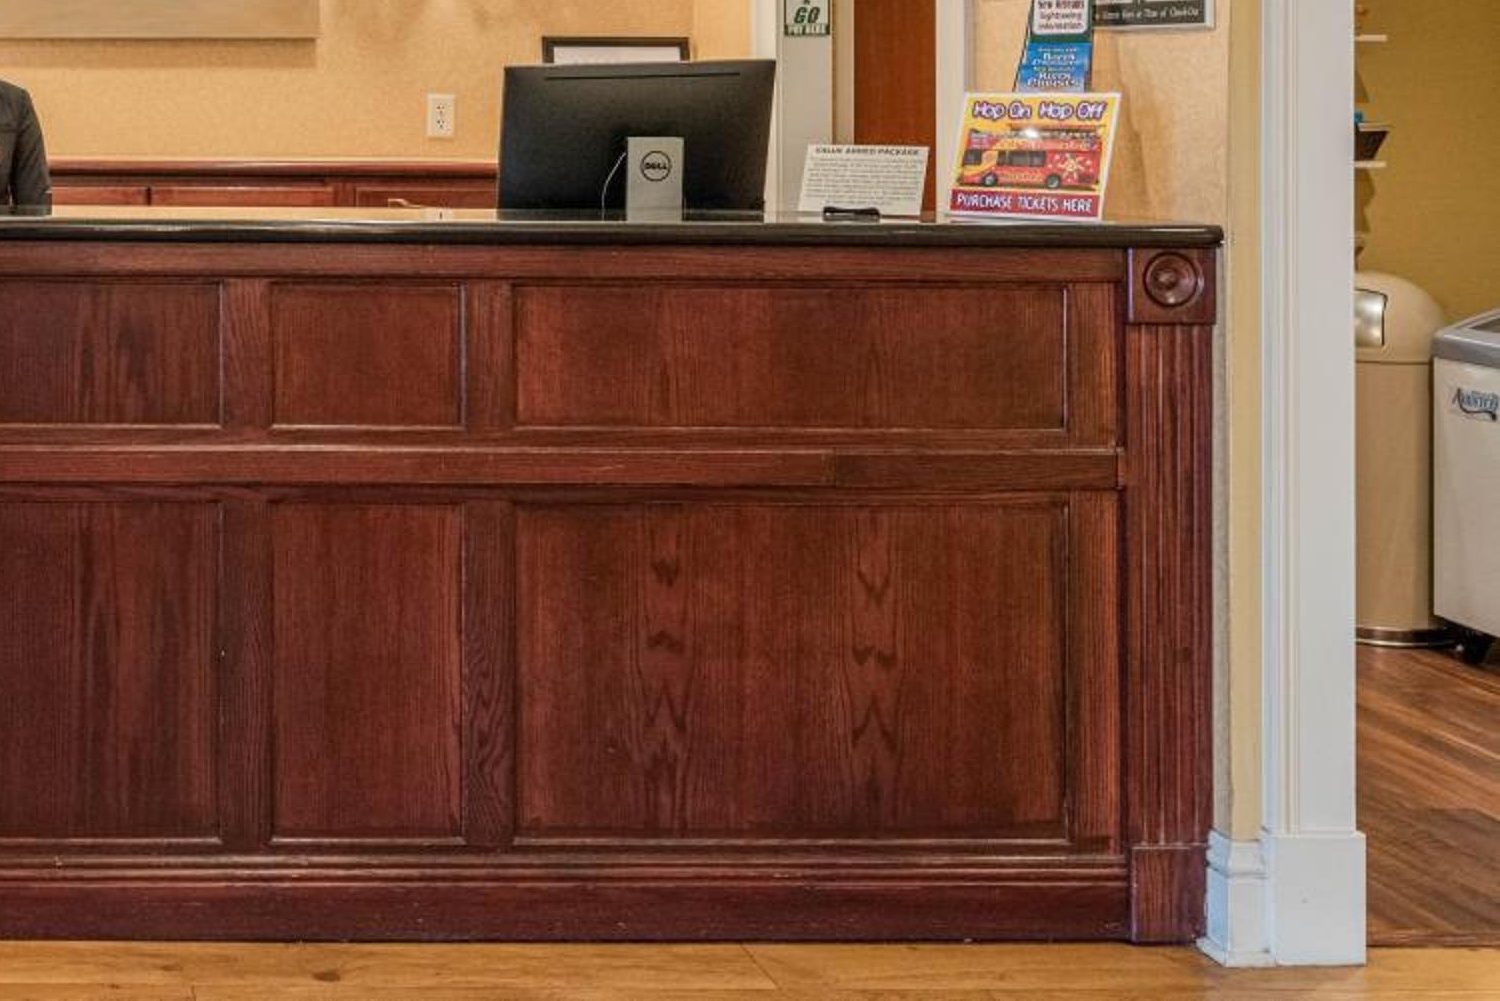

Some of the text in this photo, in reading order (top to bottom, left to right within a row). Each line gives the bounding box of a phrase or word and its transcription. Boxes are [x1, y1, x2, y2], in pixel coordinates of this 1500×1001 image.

[793, 6, 821, 24] GO
[973, 101, 1107, 120] Hop On Hop Off
[956, 193, 1093, 214] PURCHASE TICKETS HERE
